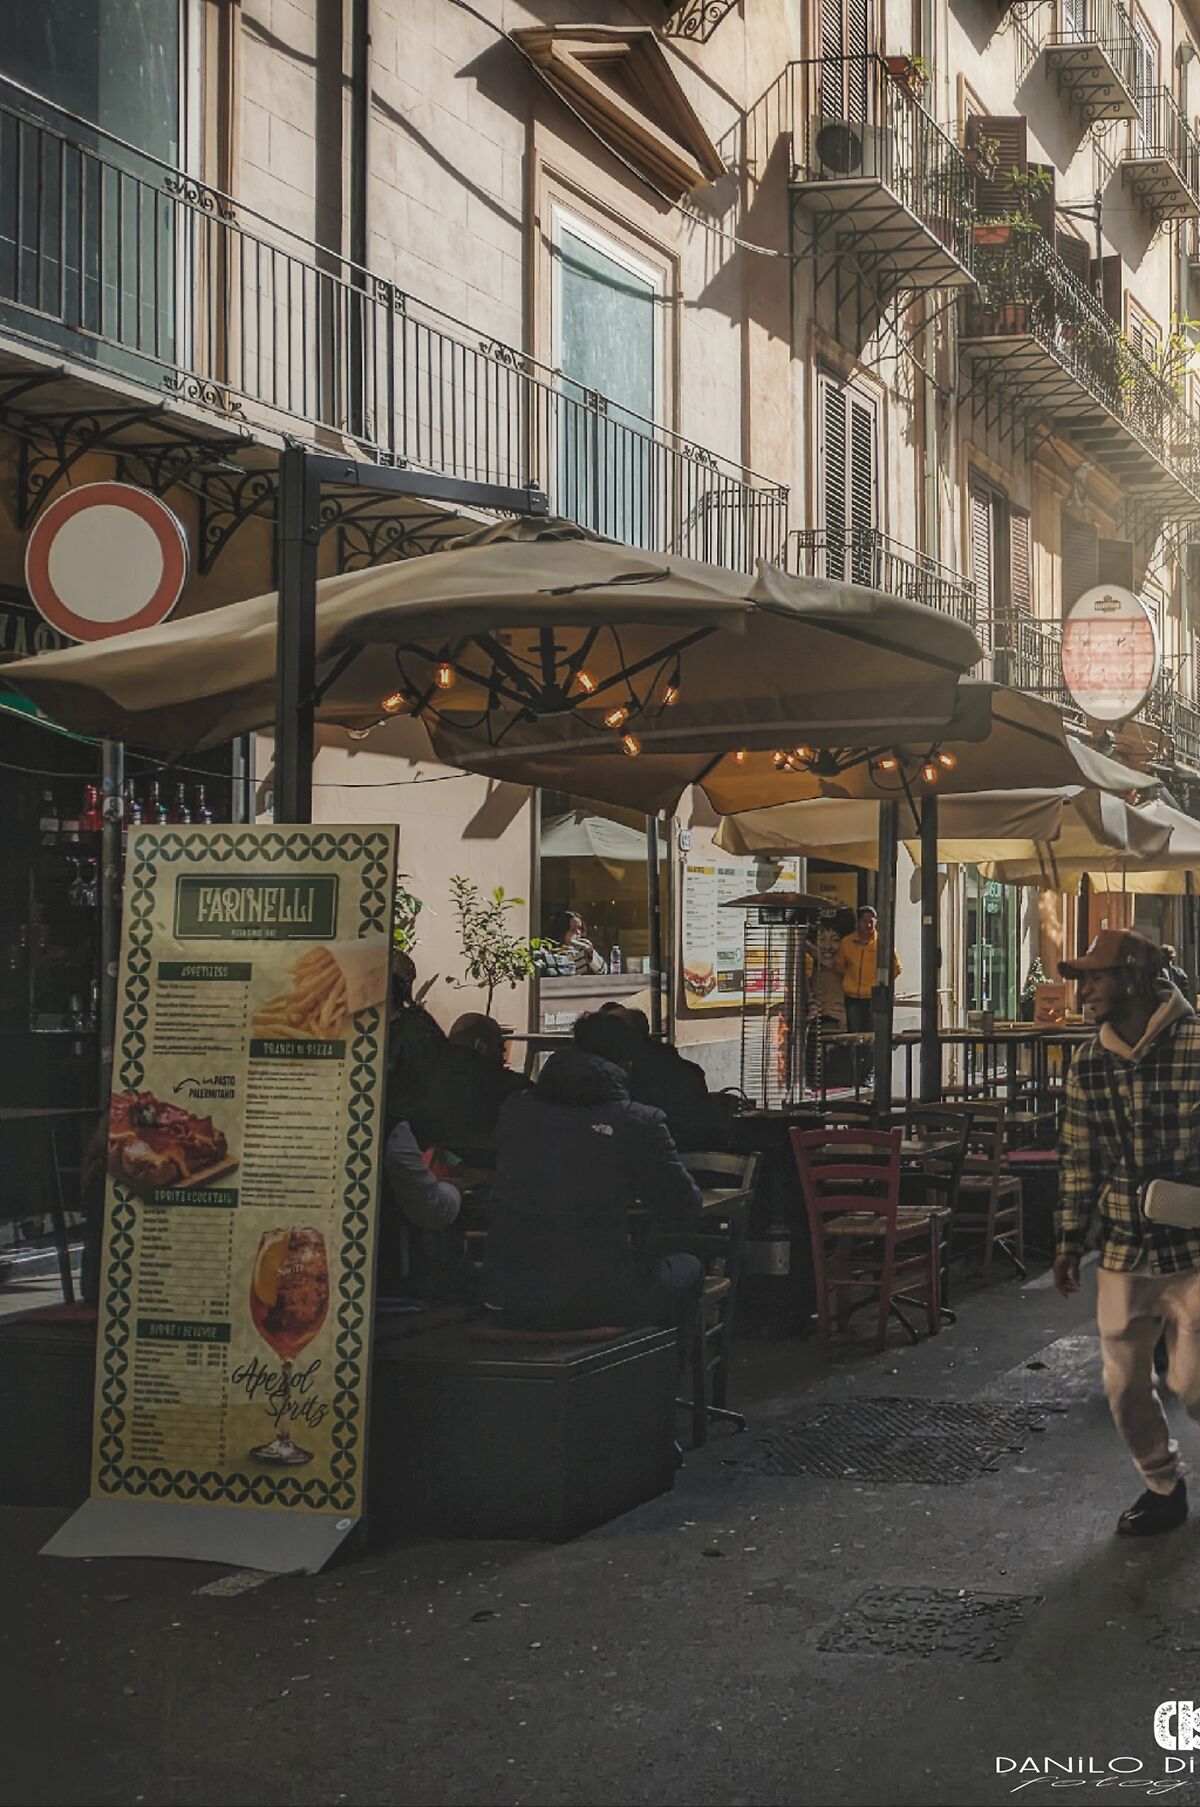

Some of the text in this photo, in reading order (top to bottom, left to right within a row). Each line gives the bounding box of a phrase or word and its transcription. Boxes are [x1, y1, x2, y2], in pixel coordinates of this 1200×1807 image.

[197, 886, 316, 923] FARINELLI
[306, 1043, 333, 1056] PIZZA
[214, 1075, 236, 1086] PASTO
[189, 1088, 235, 1099] PALERMITANO
[192, 1191, 232, 1204] COCKTAIL
[231, 1355, 321, 1401] Aperol
[264, 1391, 329, 1429] Spritz
